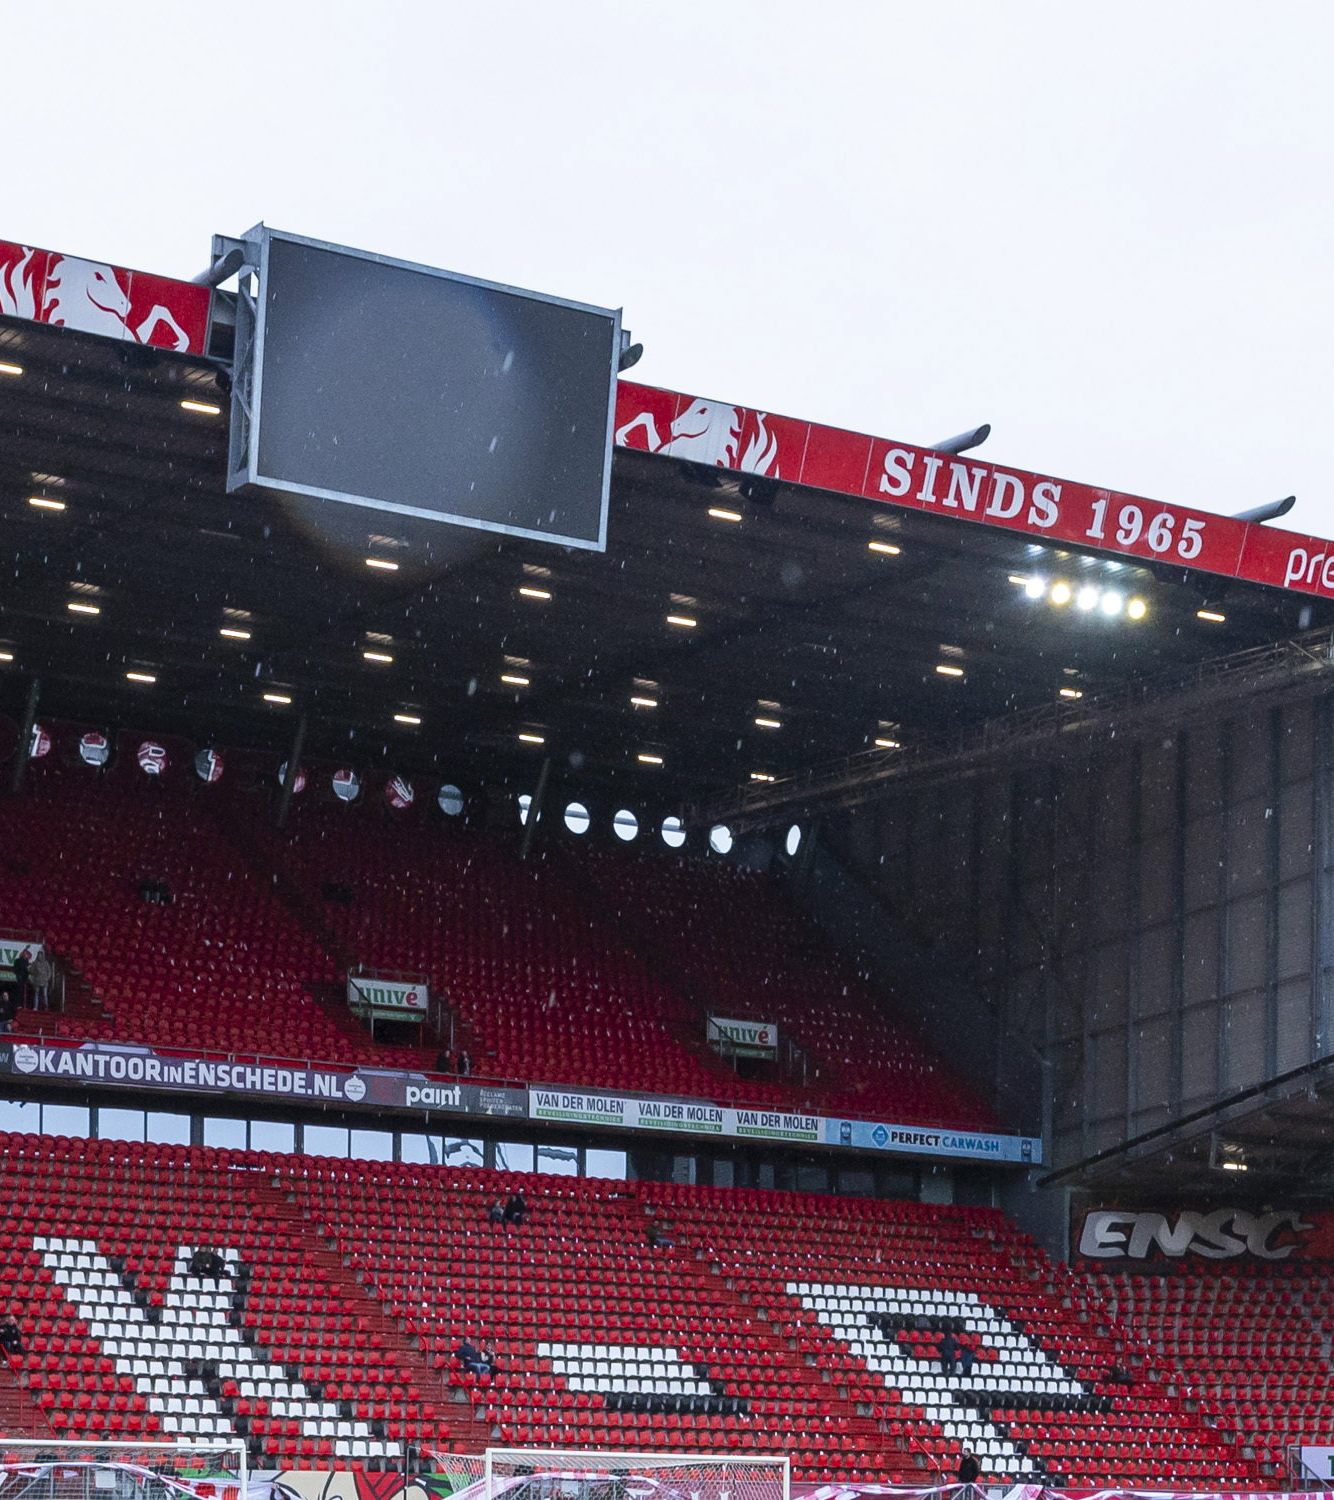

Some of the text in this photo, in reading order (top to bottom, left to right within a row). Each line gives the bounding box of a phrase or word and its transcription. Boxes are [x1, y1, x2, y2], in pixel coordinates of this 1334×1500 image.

[879, 448, 1206, 560] SINDS 1965
[359, 986, 417, 1006] univé
[405, 1085, 461, 1107] paint
[536, 1092, 624, 1114] VAN DER MOLEN
[638, 1102, 723, 1123] VAN DER MOLEN
[736, 1111, 818, 1132] VAN DER MOLEN
[891, 1131, 940, 1147] PERFECT
[942, 1135, 1000, 1153] CARWASH
